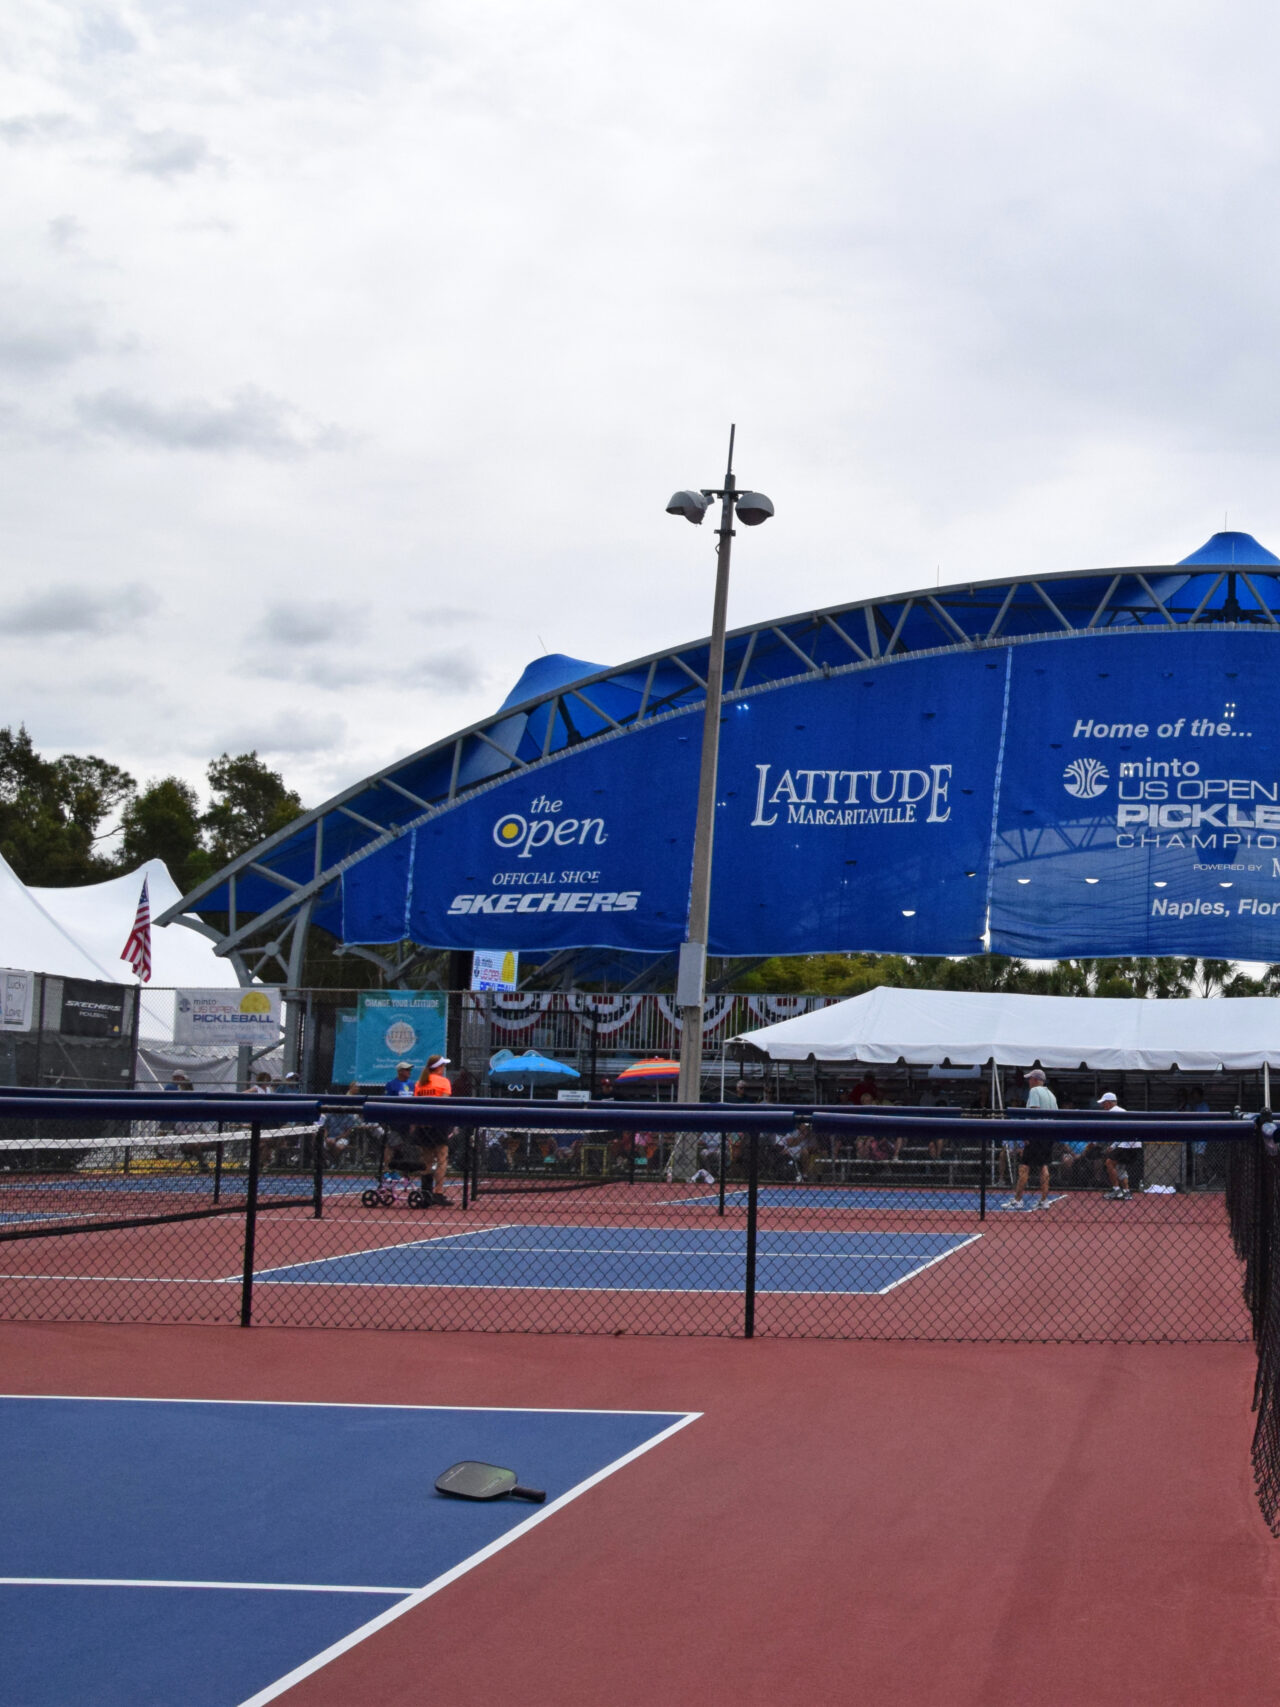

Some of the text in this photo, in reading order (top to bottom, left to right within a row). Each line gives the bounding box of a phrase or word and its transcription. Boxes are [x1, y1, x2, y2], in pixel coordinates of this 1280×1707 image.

[1072, 718, 1253, 738] Home of the...
[1119, 757, 1200, 778] minto
[751, 764, 953, 827] LATITUDE
[1118, 779, 1279, 801] US OPEN
[530, 795, 564, 814] the
[787, 804, 917, 826] MARGARITAVILLE
[492, 813, 608, 858] Open
[1192, 863, 1262, 872] POWERED BY
[491, 871, 601, 886] OFFICIAL SHOE
[447, 891, 642, 915] SKECHERS
[1151, 898, 1231, 920] Naples,
[65, 1000, 122, 1012] SKECHERS
[364, 999, 440, 1008] CHANGE YOUR LATITUDE
[192, 1014, 274, 1023] PICKLEBALL
